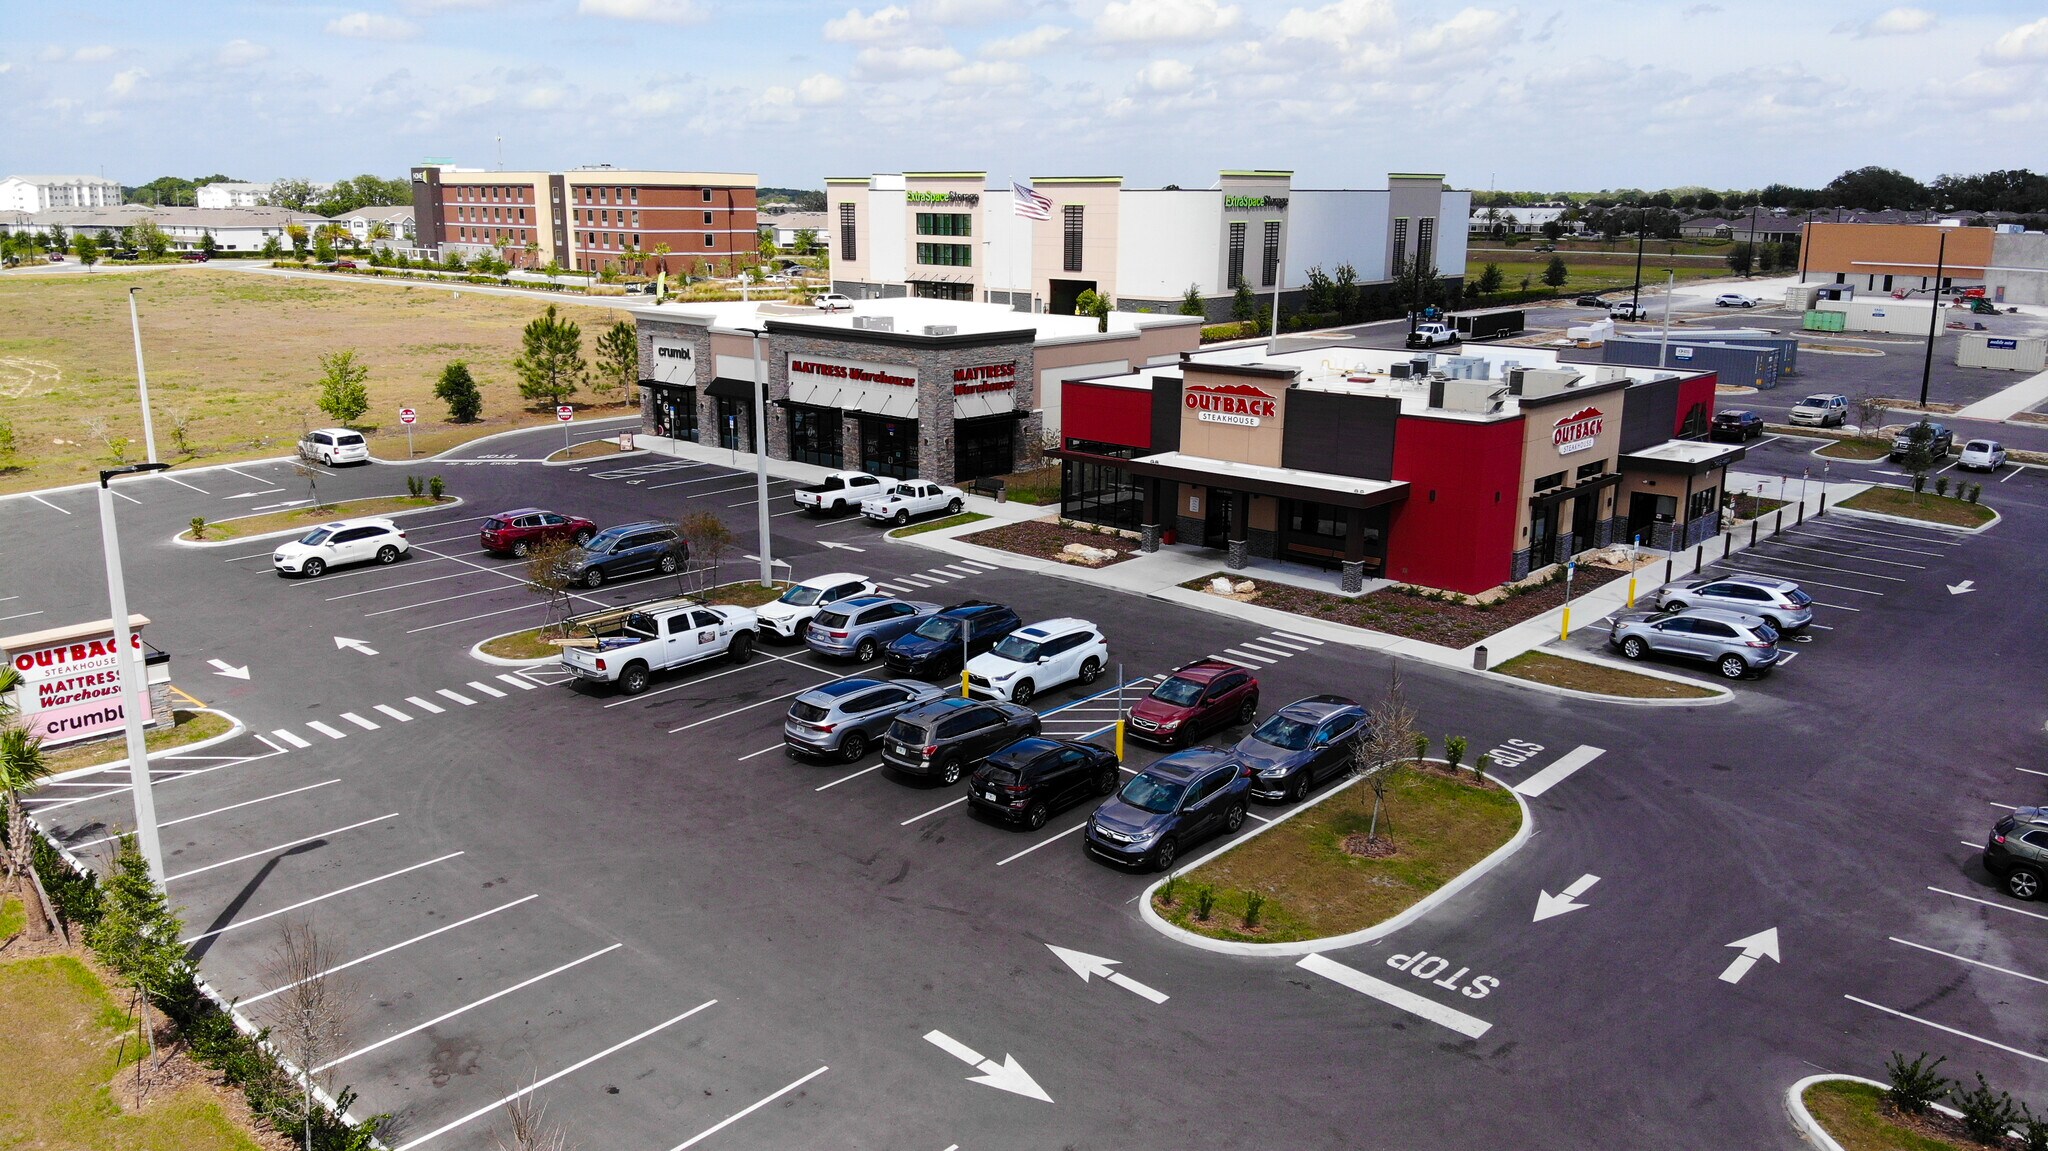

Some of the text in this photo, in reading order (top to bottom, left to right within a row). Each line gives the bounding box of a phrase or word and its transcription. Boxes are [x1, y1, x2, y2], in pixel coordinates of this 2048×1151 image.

[658, 347, 691, 360] crumbl
[792, 361, 915, 387] MATTRESS Warehouse
[954, 364, 1015, 381] MATTRESS
[954, 381, 1015, 396] Warehouse
[1185, 393, 1276, 417] OUTBACK
[1203, 413, 1255, 425] STEAKHOUSE
[1553, 418, 1603, 445] OUTBACK
[45, 657, 116, 677] STEAKHOUSE
[39, 669, 120, 696] MATTRES
[40, 685, 121, 708] Warehous
[47, 705, 124, 734] crumbl
[1484, 739, 1544, 767] STOP
[1386, 951, 1500, 999] STOP
